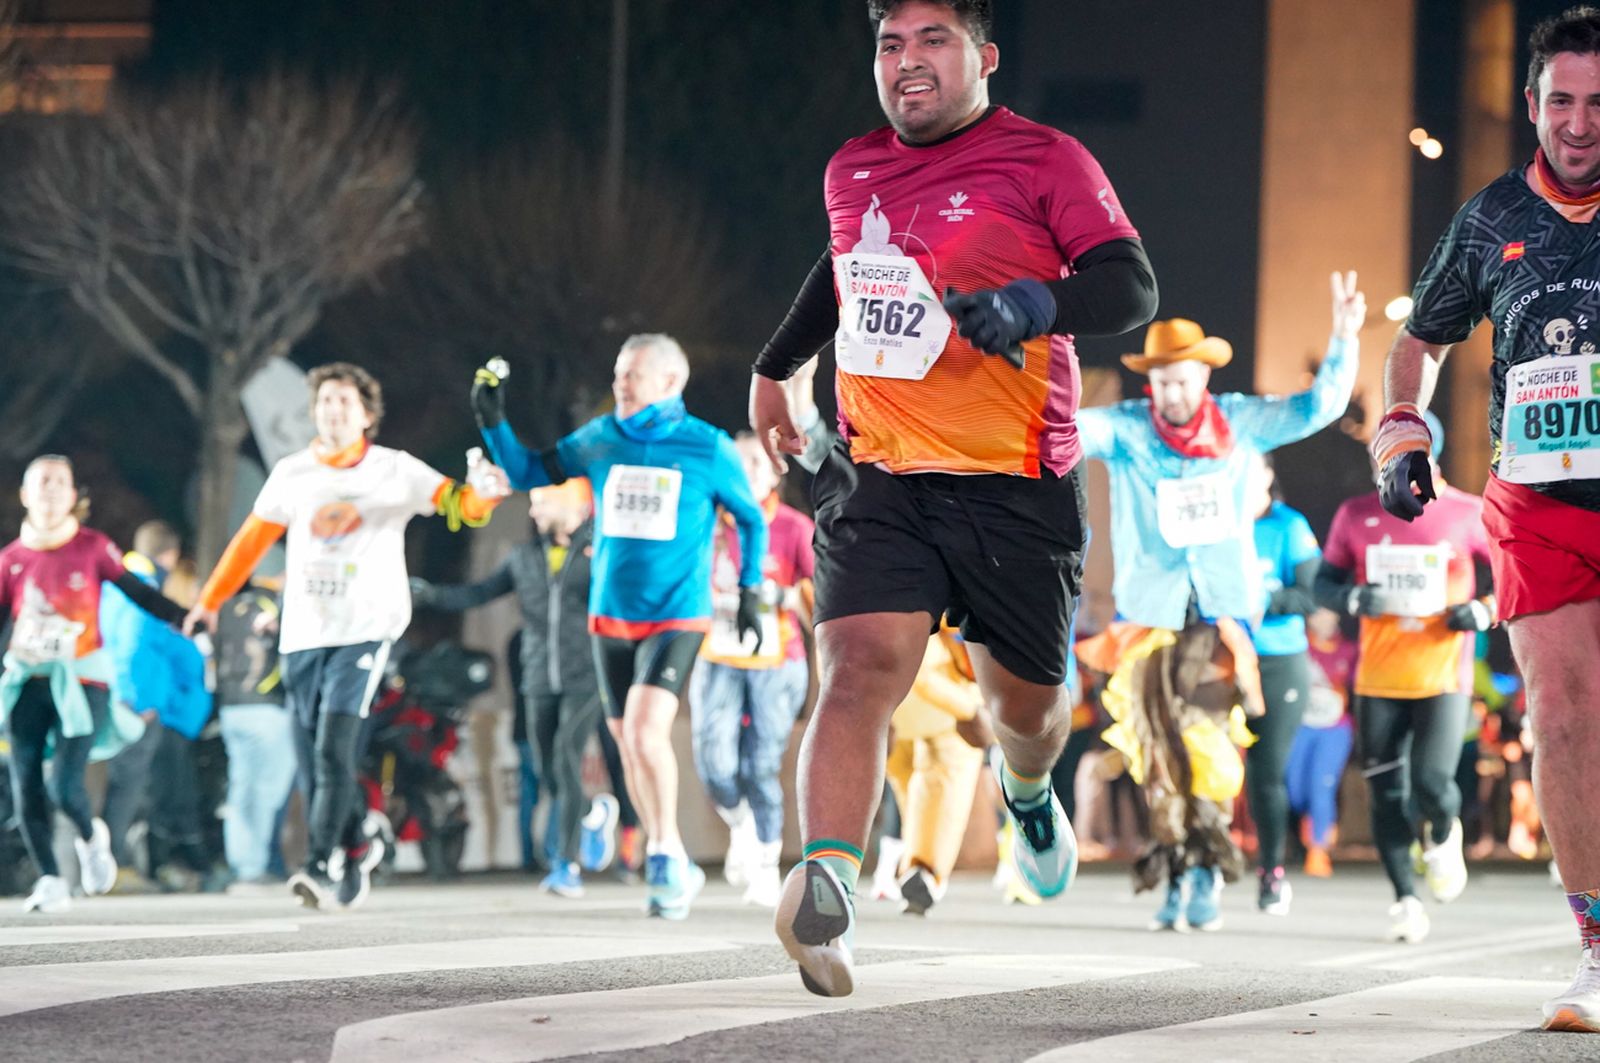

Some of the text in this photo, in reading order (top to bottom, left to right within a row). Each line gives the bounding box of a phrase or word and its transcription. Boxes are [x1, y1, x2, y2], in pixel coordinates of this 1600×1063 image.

[860, 268, 911, 282] NOCHE DE
[856, 298, 926, 338] 7562
[1503, 289, 1540, 338] AMIGOS
[1546, 282, 1566, 293] DE
[1527, 370, 1578, 386] NOCHE DE
[1515, 389, 1536, 404] SAN
[1537, 382, 1579, 401] ANTÓN
[1524, 399, 1600, 441] 8970
[614, 491, 662, 514] 3899
